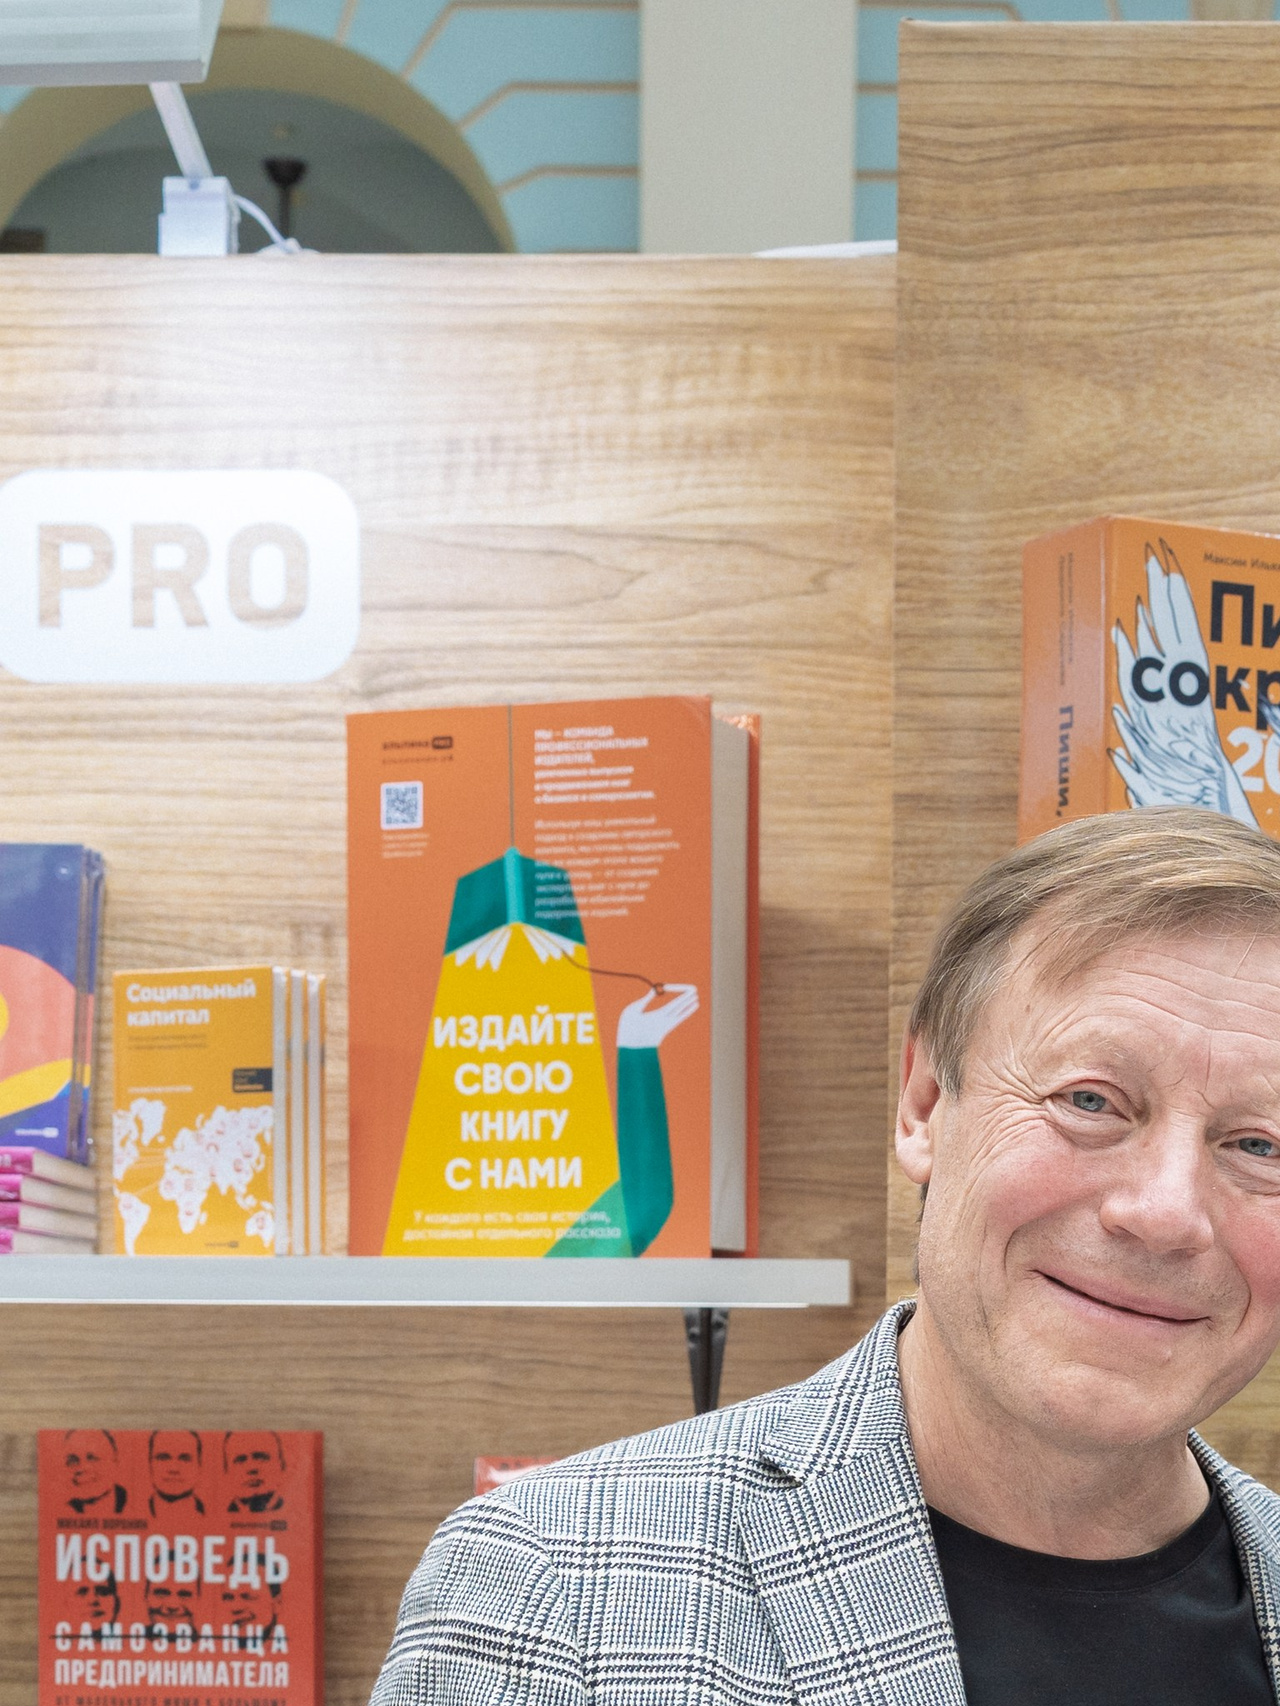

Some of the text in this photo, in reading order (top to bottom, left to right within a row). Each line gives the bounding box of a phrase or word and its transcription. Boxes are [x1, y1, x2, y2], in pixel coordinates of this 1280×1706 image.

[37, 523, 310, 629] PRO
[1056, 705, 1074, 817] Пиши,
[126, 979, 257, 1004] Социальный
[127, 1008, 210, 1027] капитал
[433, 1004, 595, 1052] ИЗДАЙТЕ
[454, 1060, 573, 1095] СВОЮ
[460, 1109, 569, 1142] КНИГУ
[444, 1156, 583, 1190] С НАМИ
[55, 1533, 290, 1590] ИСПОВЕДЬ
[54, 1620, 289, 1657] САМОЗВАНЦА
[54, 1658, 290, 1689] ПРЕДПРИНИМАТЕЛЯ
